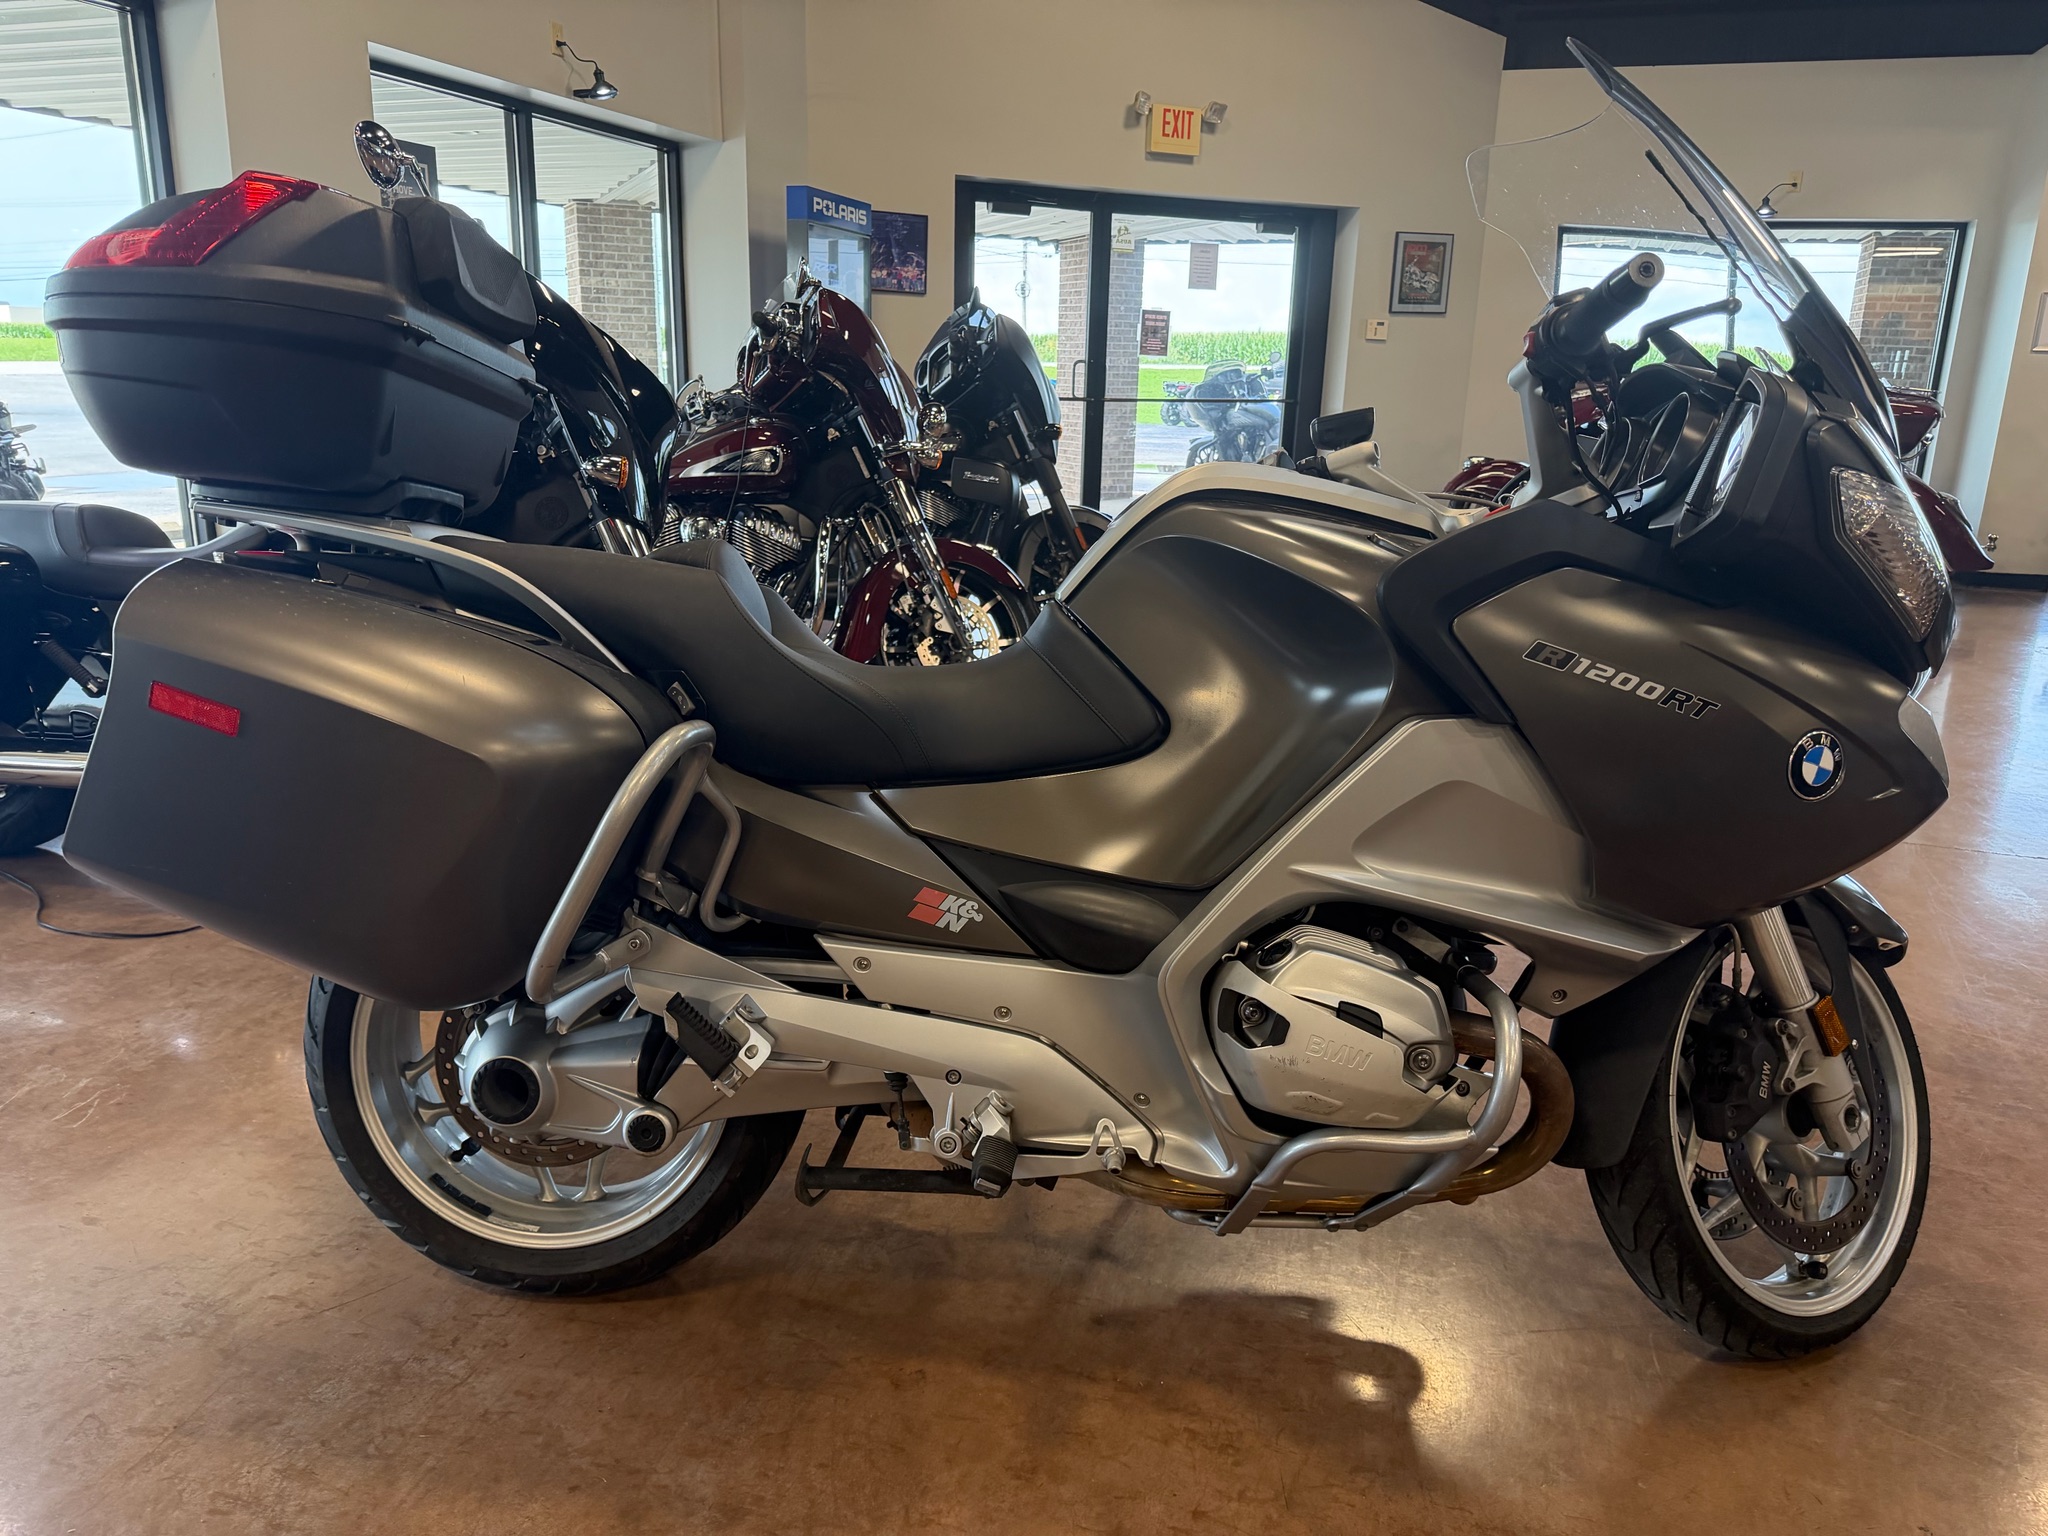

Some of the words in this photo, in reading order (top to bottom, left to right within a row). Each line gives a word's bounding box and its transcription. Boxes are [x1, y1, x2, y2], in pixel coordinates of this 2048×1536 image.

[1162, 107, 1194, 140] EXIT
[813, 197, 867, 225] POLARIS
[1801, 733, 1842, 762] BMW
[1305, 1033, 1374, 1072] BMW
[1759, 1060, 1772, 1099] BMW
